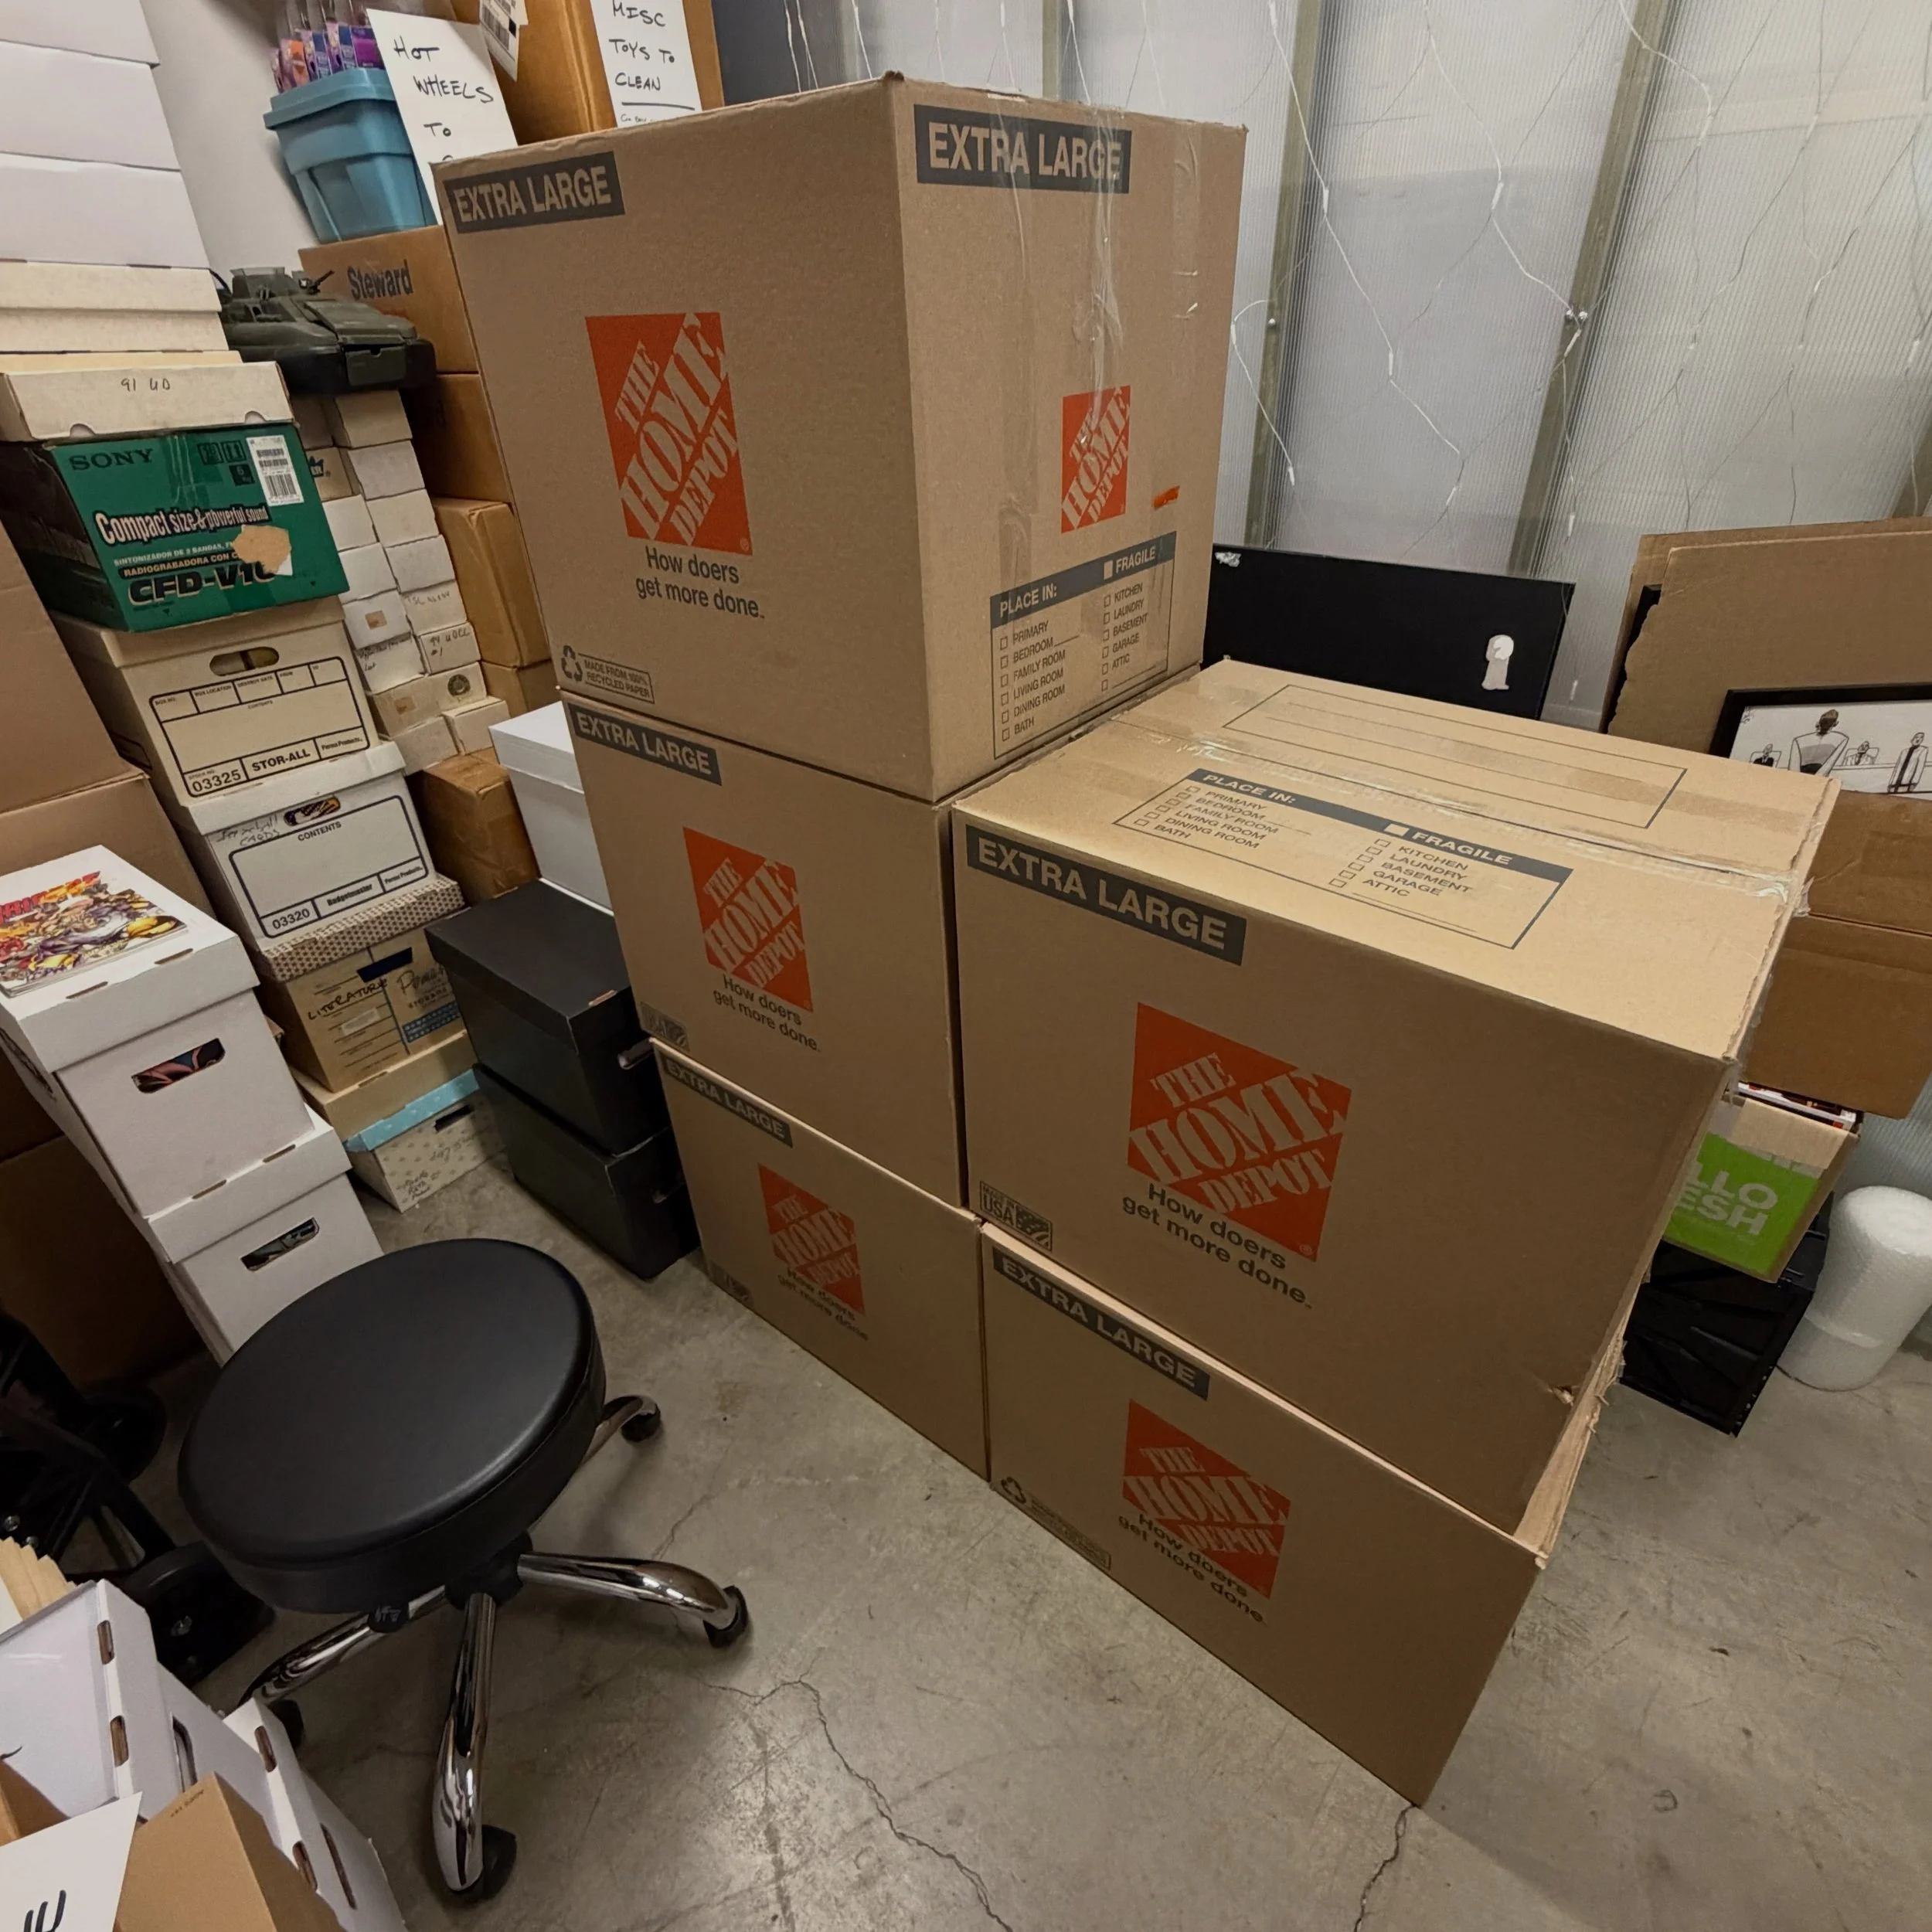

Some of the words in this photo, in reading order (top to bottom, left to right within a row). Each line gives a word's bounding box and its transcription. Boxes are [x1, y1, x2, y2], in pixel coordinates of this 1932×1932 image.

[613, 0, 665, 27] MISC
[393, 36, 440, 62] HOT
[609, 39, 650, 61] TOYS
[413, 74, 494, 104] WHEELS
[615, 72, 661, 91] CLEAN
[928, 121, 1030, 175] EXTRA
[1039, 133, 1122, 181] LARGE
[453, 179, 527, 223] EXTRA
[527, 165, 612, 213] LARGE
[347, 259, 414, 301] Steward
[121, 377, 137, 393] 91
[614, 339, 660, 435] THE
[621, 313, 730, 540] HOME
[69, 448, 154, 471] SONY
[1062, 387, 1130, 529] HOME
[669, 406, 739, 546] DEPOT
[1087, 434, 1128, 523] DEPOT
[95, 510, 172, 545] Compact
[168, 509, 195, 534] size
[193, 508, 207, 530] &
[205, 506, 247, 531] powerful
[245, 505, 269, 522] sound
[114, 552, 172, 566] SINTONIZADOR
[124, 557, 209, 577] RADIOGRABADORA
[210, 553, 230, 563] CON
[646, 545, 683, 574] How
[688, 554, 740, 584] doers
[1115, 545, 1157, 574] FRAGILE
[635, 577, 662, 600] get
[665, 582, 709, 608] more
[999, 587, 1039, 618] PLACE
[1043, 583, 1057, 601] IN:
[1114, 582, 1143, 603] KITCHEN
[1112, 613, 1148, 637] BASEMENT
[1114, 598, 1145, 621] LAUNDRY
[1012, 621, 1049, 645] PRIMARY
[1112, 632, 1140, 654] GARAGE
[1012, 637, 1054, 664] BEDROOM
[1013, 658, 1041, 682] FAMILY
[1042, 649, 1066, 670] ROOM
[1111, 653, 1131, 671] ATTIC
[584, 659, 605, 675] MADE
[606, 665, 628, 682] FROM
[586, 671, 624, 691] RECYCLED
[625, 682, 651, 698] PAPER
[1013, 677, 1039, 700] LIVING
[1040, 667, 1064, 687] ROOM
[1013, 696, 1041, 717] DINING
[1042, 685, 1066, 706] ROOM
[1014, 717, 1035, 735] BATH
[576, 711, 640, 752] EXTRA
[641, 732, 712, 775] LARGE
[251, 748, 311, 772] STOR-ALL
[192, 769, 242, 793] 03325
[1202, 774, 1266, 797] PLACE
[1267, 789, 1297, 804] IN:
[1195, 798, 1267, 821] BEDROOM
[1205, 791, 1267, 811] PRIMARY
[298, 821, 342, 842] CONTENTS
[1153, 824, 1192, 839] BATH
[1164, 817, 1213, 835] DINING
[1214, 831, 1260, 849] ROOM
[1174, 810, 1222, 830] LIVING
[1220, 823, 1267, 841] ROOM
[1185, 804, 1236, 825] FAMILY
[1234, 817, 1280, 835] ROOM
[1398, 845, 1469, 871] KITCHEN
[1411, 831, 1514, 866] FRAGILE
[703, 856, 743, 908] THE
[1372, 870, 1444, 896] GARAGE
[1381, 862, 1474, 893] BASEMENT
[1389, 854, 1469, 881] LAUNDRY
[978, 837, 1087, 900] EXTRA
[1097, 878, 1228, 951] LARGE
[1362, 879, 1411, 897] ATTIC
[271, 907, 311, 930] 03320
[704, 859, 799, 974] HOME
[744, 920, 805, 988] DEPOT
[713, 989, 736, 1010] get
[739, 1001, 776, 1029] more
[723, 973, 754, 1003] How
[759, 994, 802, 1026] doers
[1149, 1051, 1236, 1109] THE
[665, 1059, 722, 1102] EXTRA
[724, 1090, 785, 1139] LARGE
[1129, 1071, 1349, 1187] HOME
[1197, 1148, 1333, 1216] DEPOT
[983, 1192, 1015, 1226] USA
[772, 1207, 855, 1267] HOME
[1122, 1195, 1160, 1226] get
[1166, 1219, 1231, 1264] more
[1148, 1183, 1204, 1225] How
[1209, 1218, 1287, 1271] doers
[1002, 1257, 1089, 1323] EXTRA
[1096, 1313, 1197, 1389] LARGE
[1138, 1445, 1206, 1474] THE
[1123, 1475, 1287, 1527] HOME
[1117, 1515, 1148, 1543] get
[1153, 1542, 1206, 1583] more
[1178, 1523, 1280, 1557] DEPOT
[1138, 1513, 1182, 1552] How
[1188, 1549, 1249, 1599] doers
